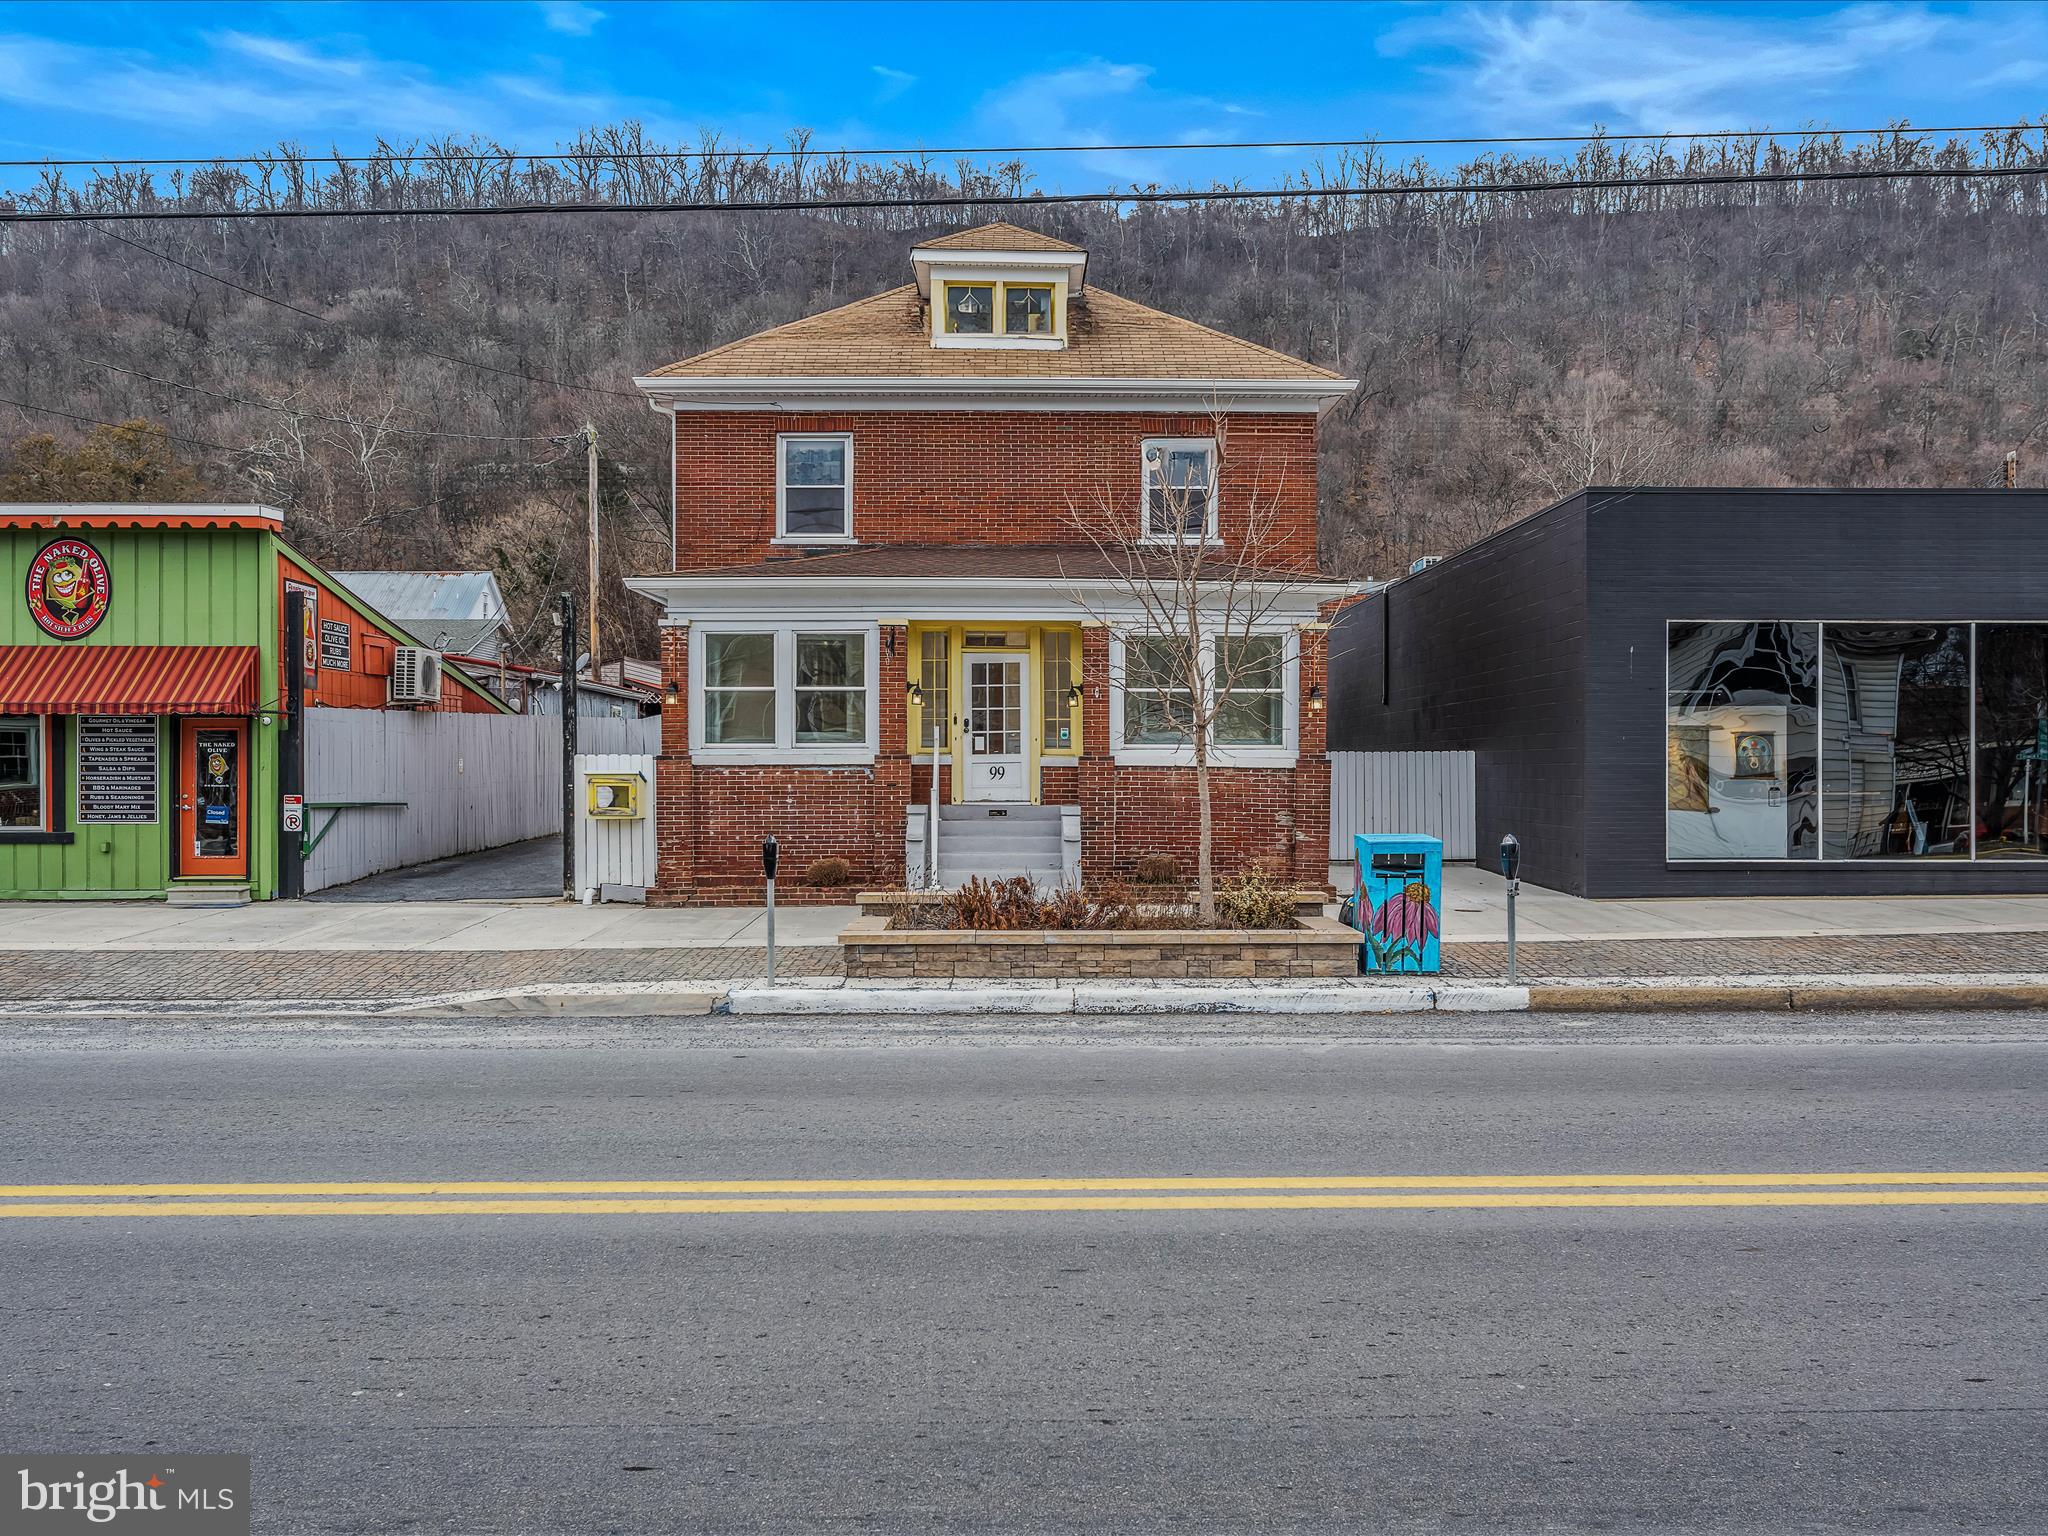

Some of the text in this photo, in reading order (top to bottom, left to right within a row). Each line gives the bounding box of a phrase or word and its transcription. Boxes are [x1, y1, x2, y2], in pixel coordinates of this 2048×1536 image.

[32, 544, 104, 594] THE NAKED OLIVE
[323, 622, 347, 633] HOT SAUCE
[325, 634, 338, 643] OLIVE
[329, 647, 342, 656] RUBS
[322, 658, 348, 668] MUCH MORE
[990, 766, 1005, 780] 99
